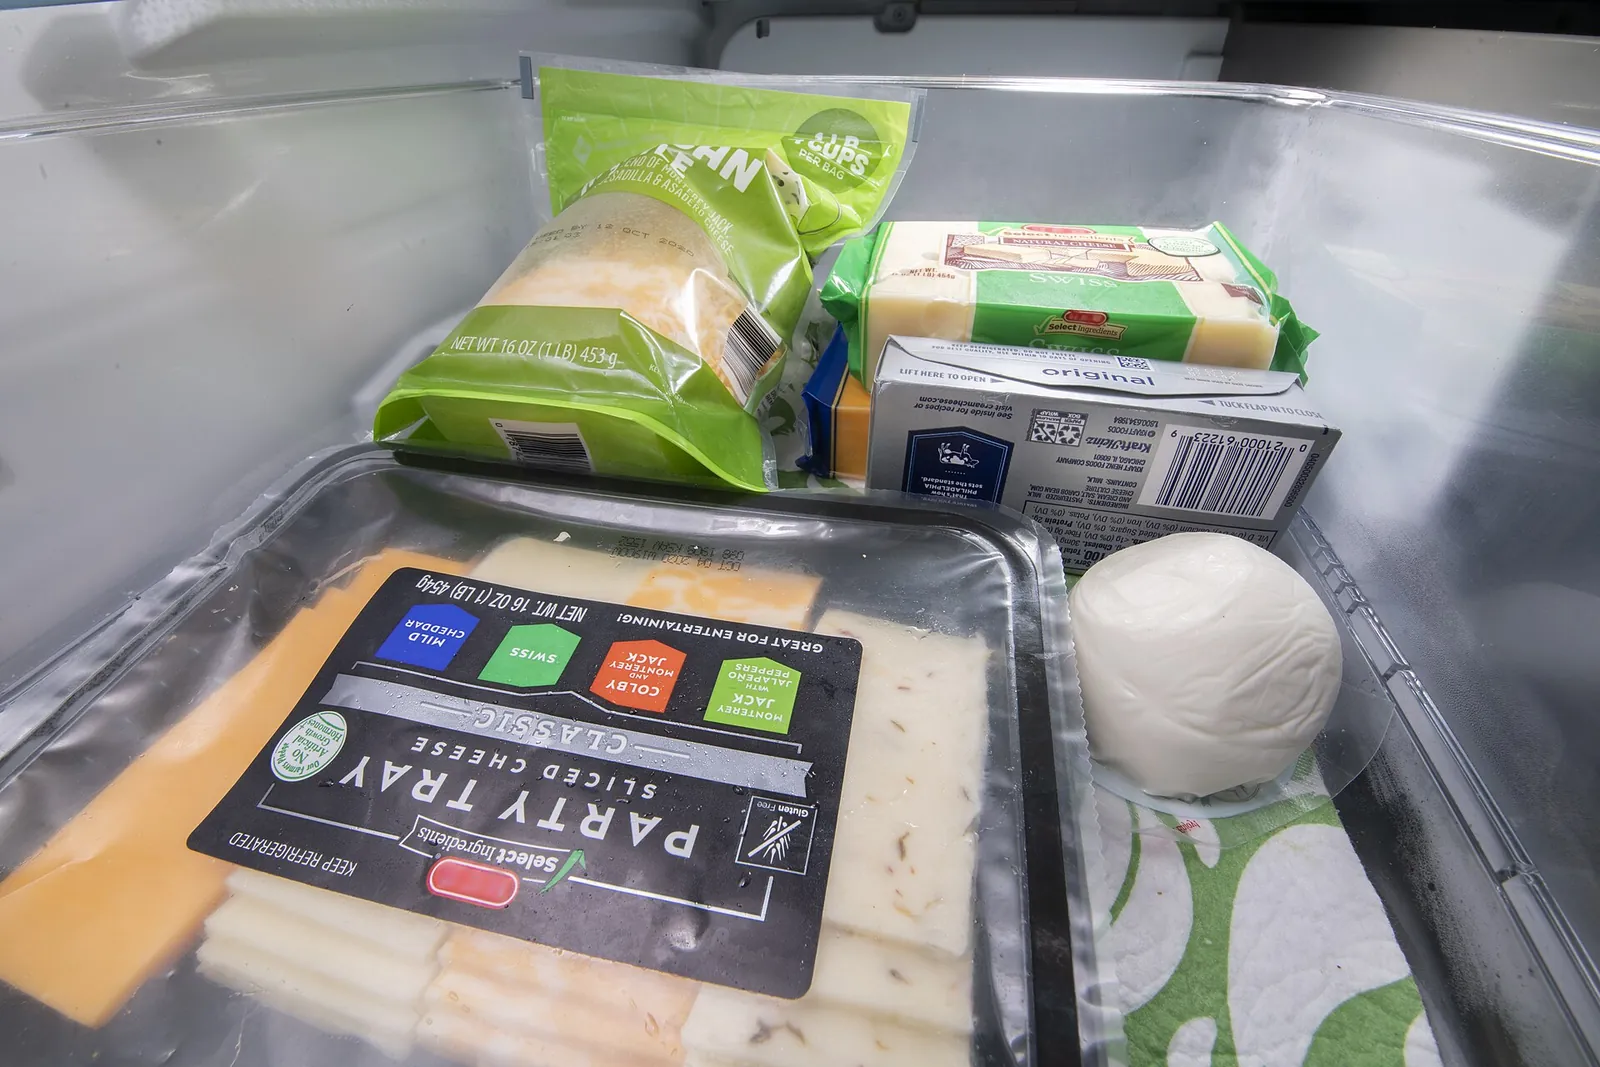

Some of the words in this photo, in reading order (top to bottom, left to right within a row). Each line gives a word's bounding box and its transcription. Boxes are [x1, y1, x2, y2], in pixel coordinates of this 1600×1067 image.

[799, 148, 821, 169] PER
[822, 155, 845, 180] BAG
[1048, 322, 1077, 332] Select
[1077, 324, 1119, 338] Ingredients
[451, 336, 478, 351] NET
[477, 337, 501, 353] WT
[501, 340, 516, 355] 16
[518, 340, 537, 356] OZ
[554, 343, 578, 363] LB)
[580, 348, 606, 364] 453
[900, 368, 919, 377] LIFT
[920, 370, 945, 379] HERE
[947, 372, 958, 380] TO
[959, 373, 986, 384] OPEN
[1042, 368, 1155, 387] original
[919, 396, 994, 409] creamcheese.com
[925, 402, 956, 413] recipes
[995, 404, 1013, 413] visit
[956, 407, 969, 415] for
[971, 408, 997, 418] inside
[997, 411, 1013, 420] See
[1170, 429, 1179, 438] 9
[1194, 432, 1237, 446] 61223
[1240, 437, 1284, 452] 21000
[1299, 444, 1308, 453] 0
[920, 475, 955, 486] standard.
[968, 482, 984, 490] sets
[923, 483, 978, 496] PHILADELPHIA
[1044, 517, 1074, 528] Protein
[1093, 524, 1107, 532] 0%
[1126, 519, 1142, 527] Iron
[1065, 528, 1081, 538] Fiber
[1137, 529, 1162, 540] Added
[1059, 537, 1081, 547] 30mg
[1082, 540, 1113, 551] Cholest.
[415, 573, 451, 596] 454g
[449, 580, 477, 602] LB)
[475, 587, 494, 606] (1
[488, 592, 511, 609] OZ
[510, 596, 531, 613] 16
[532, 599, 558, 618] WT.
[555, 604, 588, 623] NET
[404, 618, 466, 639] CHEDDAR
[615, 613, 733, 640] ENTERTAINING!
[407, 631, 446, 648] MILD
[736, 631, 769, 644] FOR
[770, 637, 823, 654] GREAT
[508, 647, 558, 664] SWISS
[625, 652, 668, 667] JACK
[608, 659, 674, 677] MONTEREY
[734, 662, 790, 679] PEPPERS
[628, 672, 649, 681] AND
[727, 671, 793, 688] JALAPEÑO
[604, 678, 660, 698] COLBY
[744, 683, 769, 693] WITH
[731, 693, 776, 709] JACK
[716, 704, 784, 722] MONTEREY
[304, 727, 331, 747] Growth
[474, 708, 629, 755] CLASSIC
[292, 734, 329, 758] Artificial
[291, 748, 309, 764] No
[410, 736, 527, 774] CHEESE
[305, 760, 320, 772] Our
[339, 755, 478, 812] TRAY
[541, 763, 658, 800] SLICED
[756, 800, 777, 812] Free
[777, 804, 809, 818] Gluten
[497, 790, 700, 859] PARTY
[228, 831, 323, 868] REFRIGERATED
[416, 826, 497, 861] Ingredients
[321, 856, 358, 877] KEEP
[495, 849, 559, 873] Select
